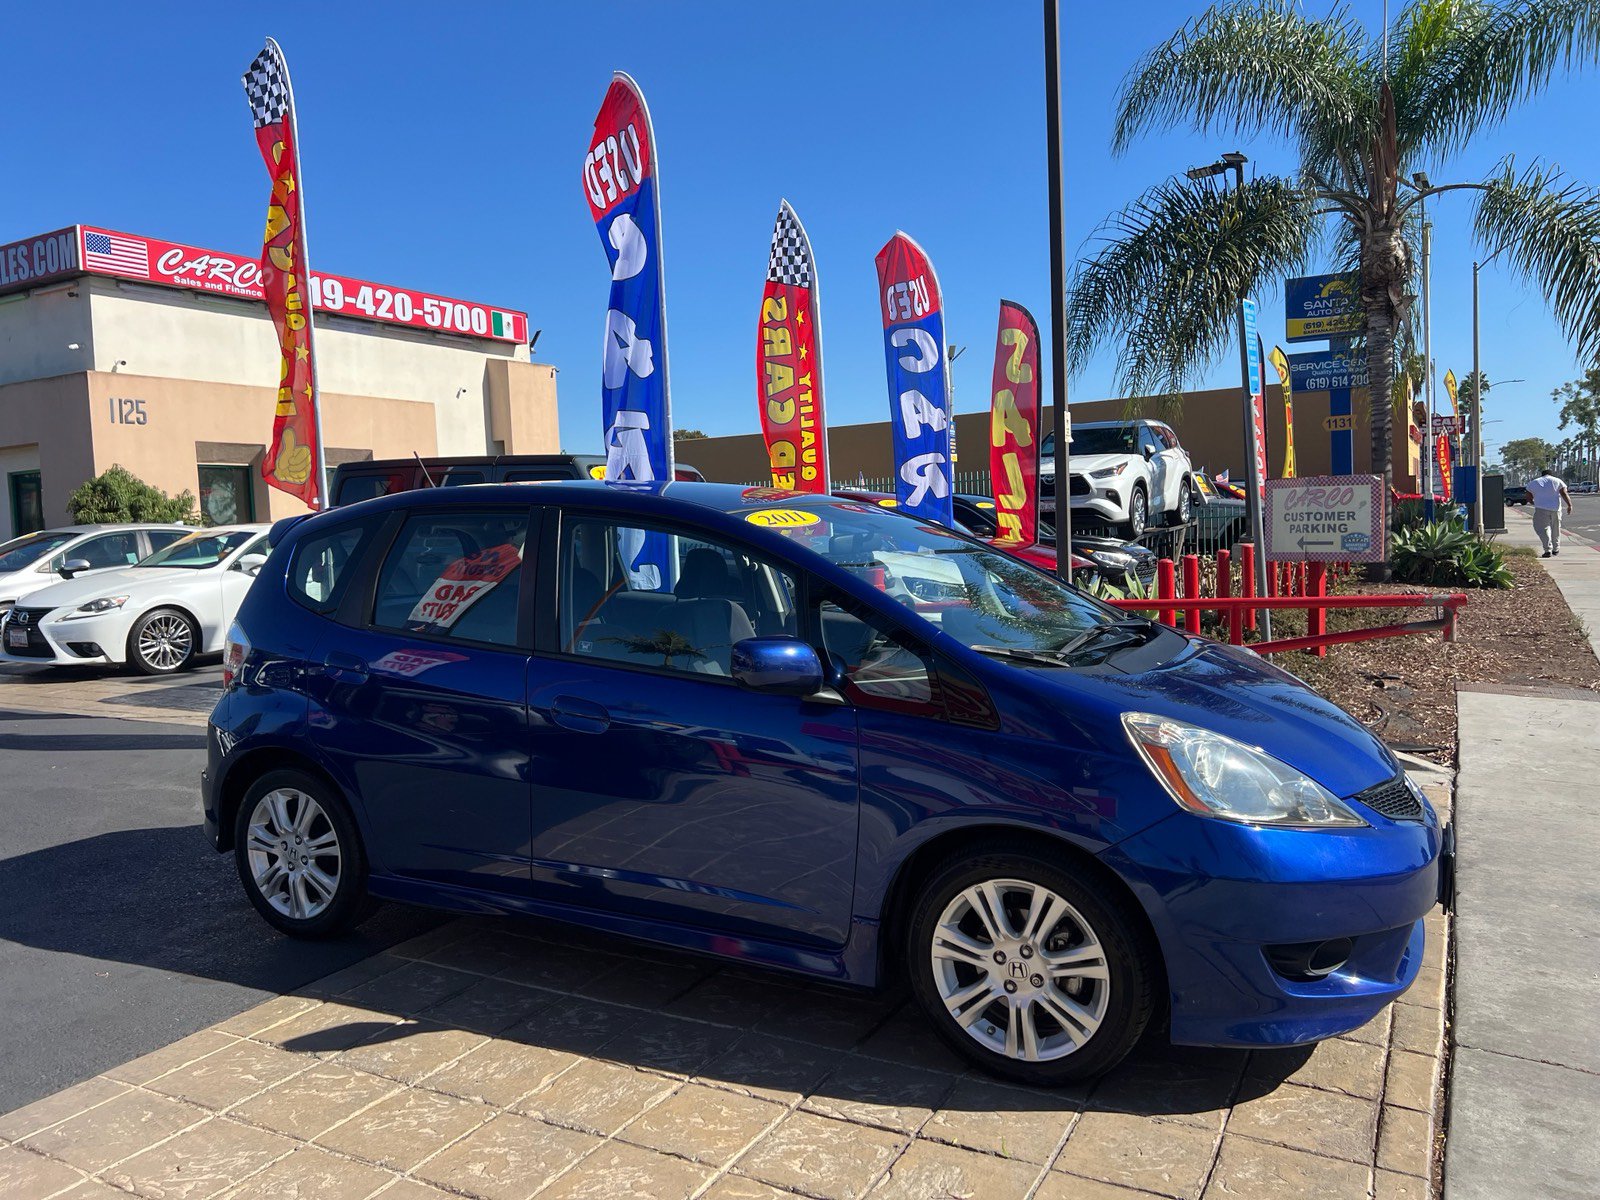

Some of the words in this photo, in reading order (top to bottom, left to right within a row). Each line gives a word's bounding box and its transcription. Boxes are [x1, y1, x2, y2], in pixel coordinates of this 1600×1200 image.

[173, 275, 202, 287] Sales
[205, 280, 223, 291] and
[225, 284, 263, 298] Finance
[309, 276, 488, 335] 19-420-5700
[1306, 309, 1332, 317] AUTO
[1291, 360, 1340, 372] SERVICE
[1306, 376, 1329, 389] (619)
[1332, 375, 1349, 387] 614
[109, 398, 148, 425] 1125
[1326, 418, 1352, 429] 1131
[1284, 487, 1355, 511] CARCO
[764, 510, 805, 526] 2011
[1283, 511, 1357, 522] CUSTOMER
[1289, 523, 1348, 534] PARKING
